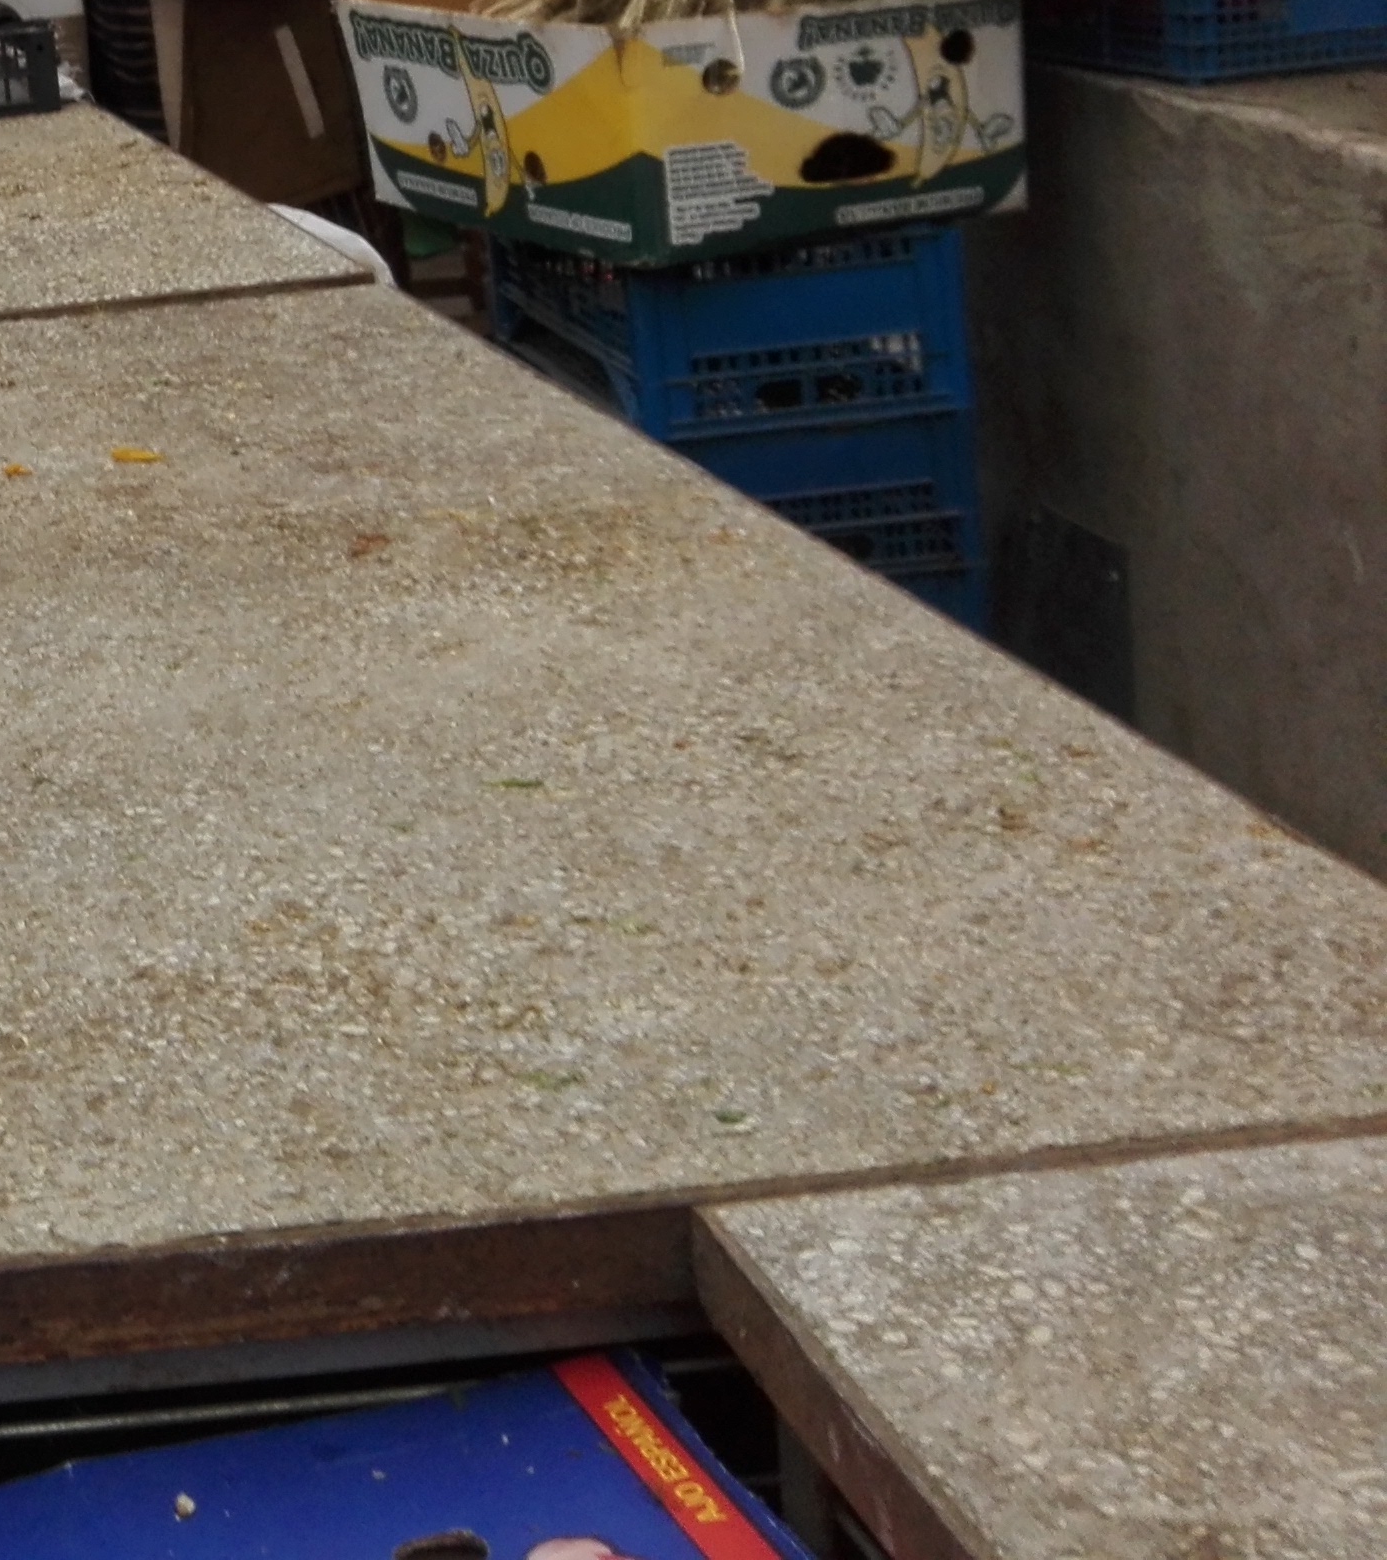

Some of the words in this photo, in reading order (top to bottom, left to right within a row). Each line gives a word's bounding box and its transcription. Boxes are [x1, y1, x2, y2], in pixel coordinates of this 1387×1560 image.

[461, 29, 555, 95] QUIZA
[603, 1394, 690, 1483] ESPAÑOL
[673, 1481, 727, 1524] AJO
